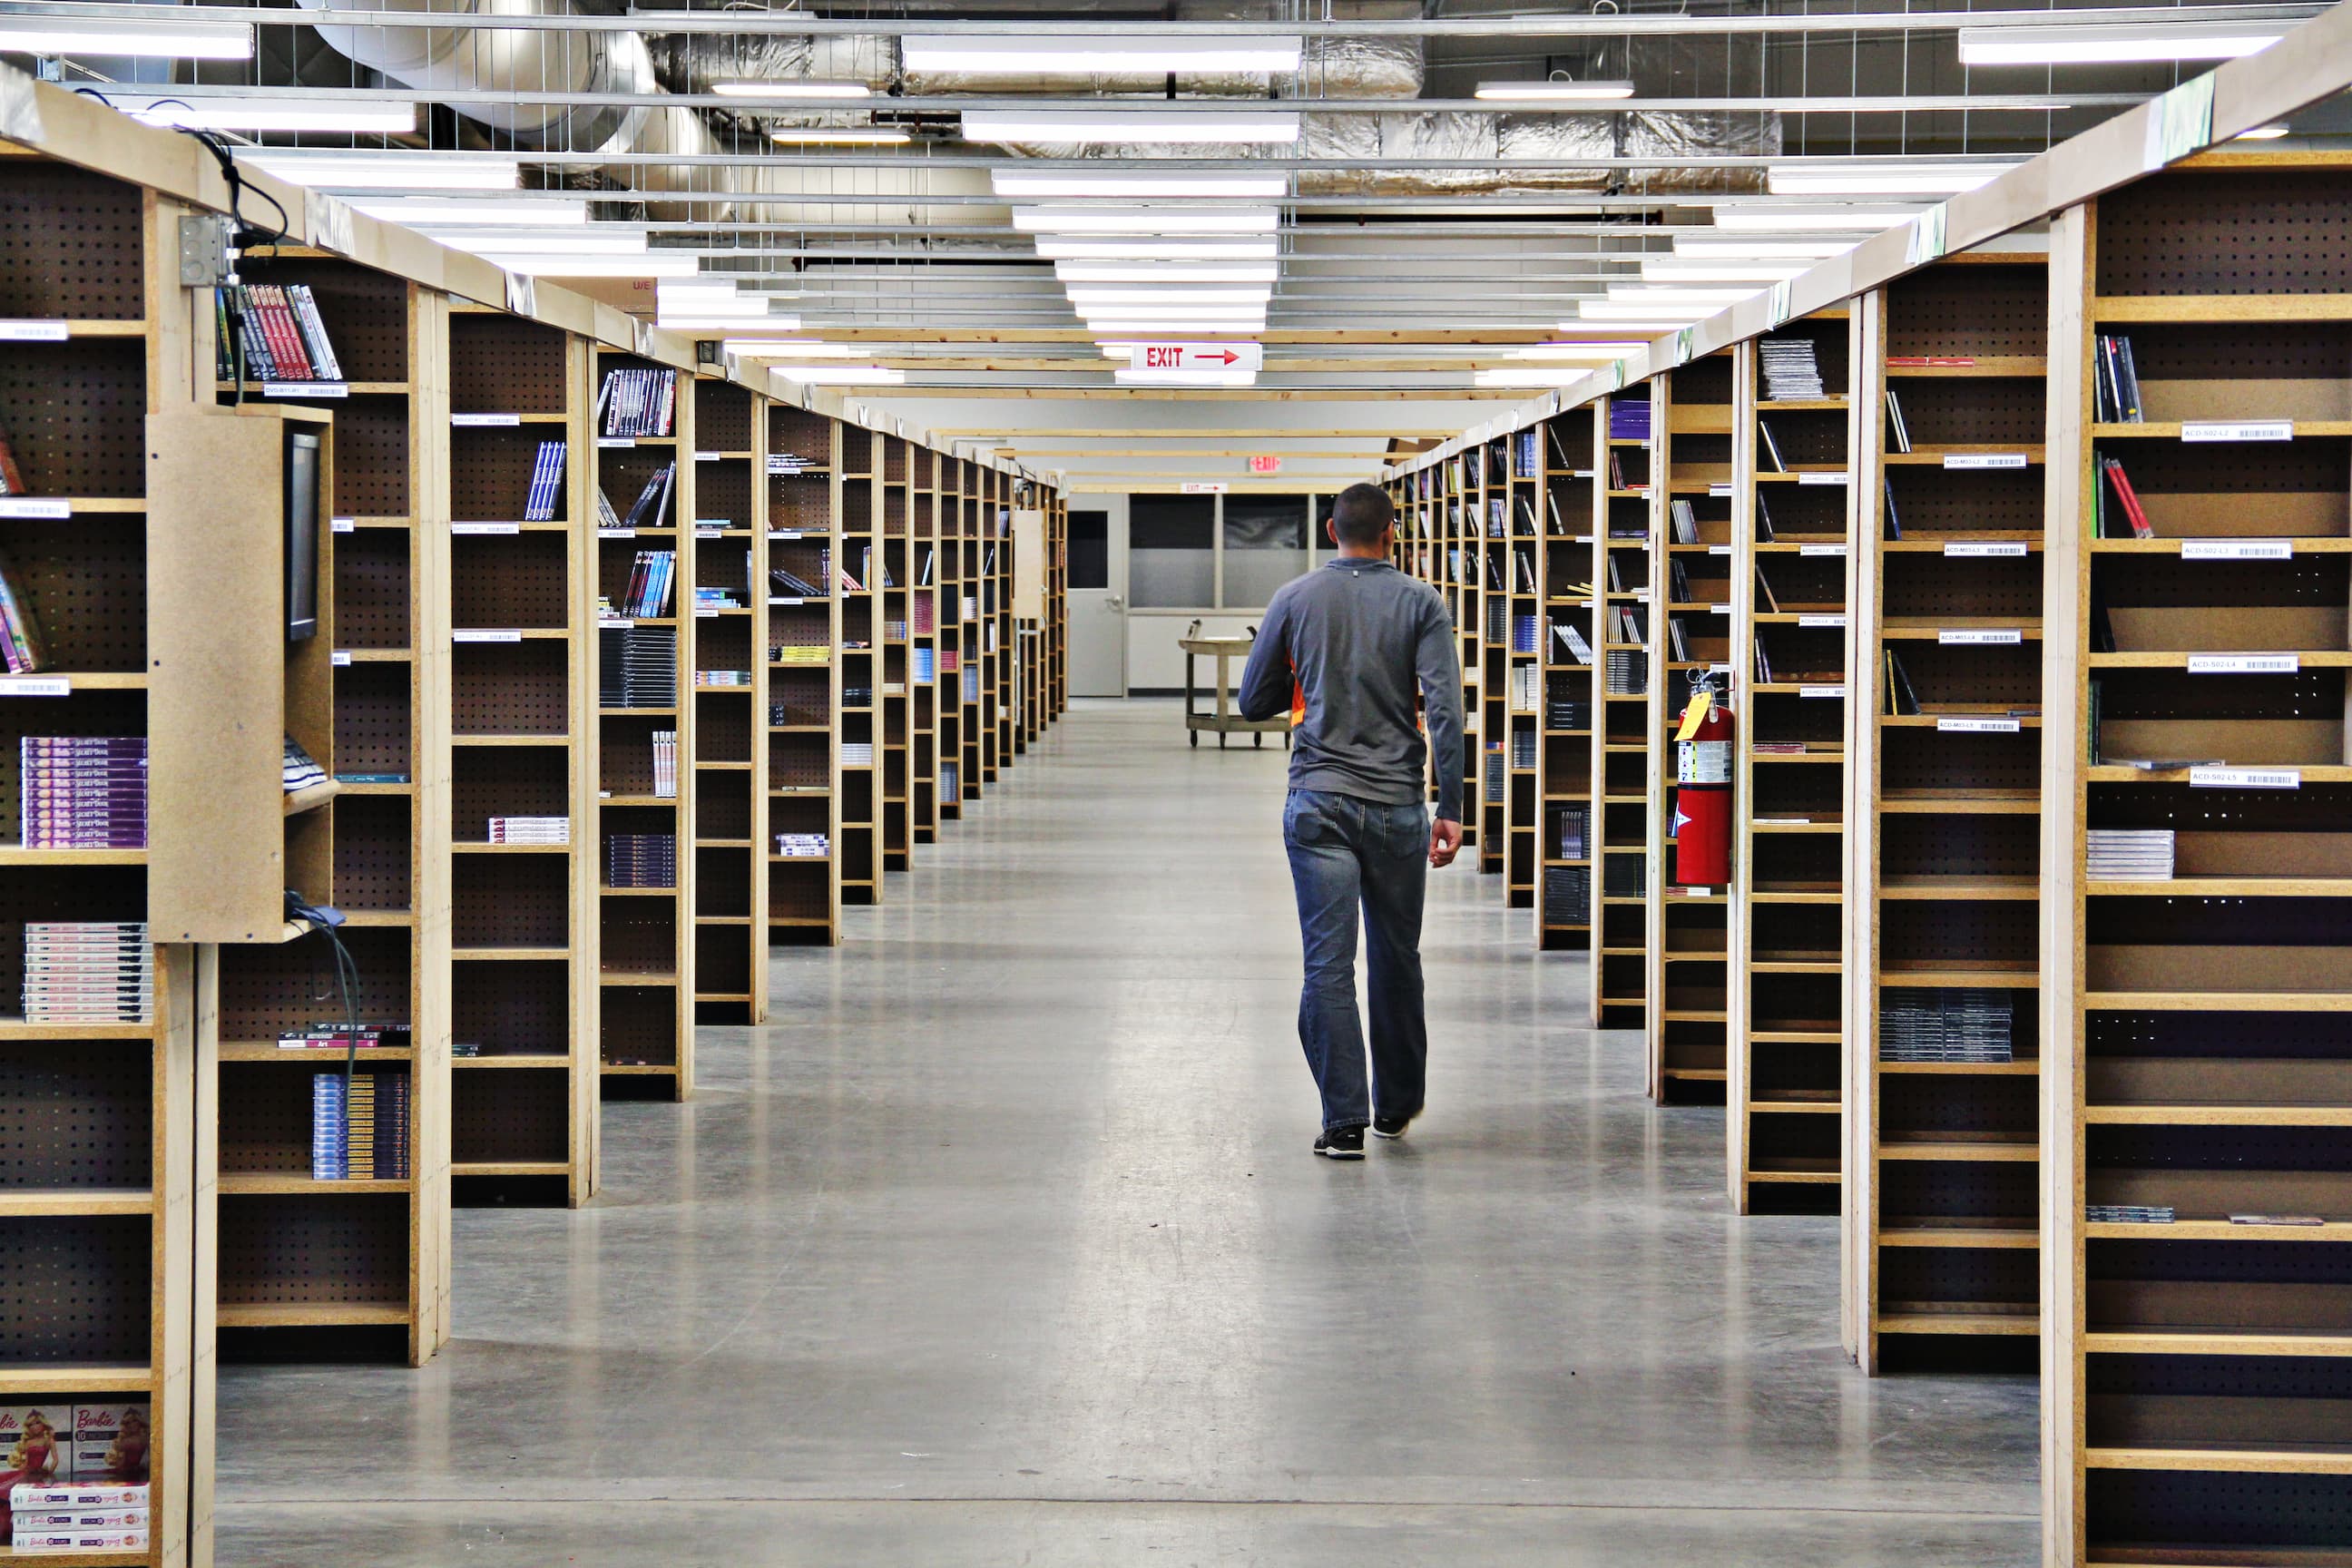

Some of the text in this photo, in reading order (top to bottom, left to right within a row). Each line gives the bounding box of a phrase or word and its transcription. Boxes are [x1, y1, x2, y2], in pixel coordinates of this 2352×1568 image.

[632, 281, 651, 290] U/E
[1146, 348, 1183, 367] EXIT
[1255, 456, 1278, 471] EXIT
[1186, 485, 1200, 493] EXIT
[2192, 773, 2237, 781] ACD-S02-L5
[77, 1409, 115, 1429] Barbie
